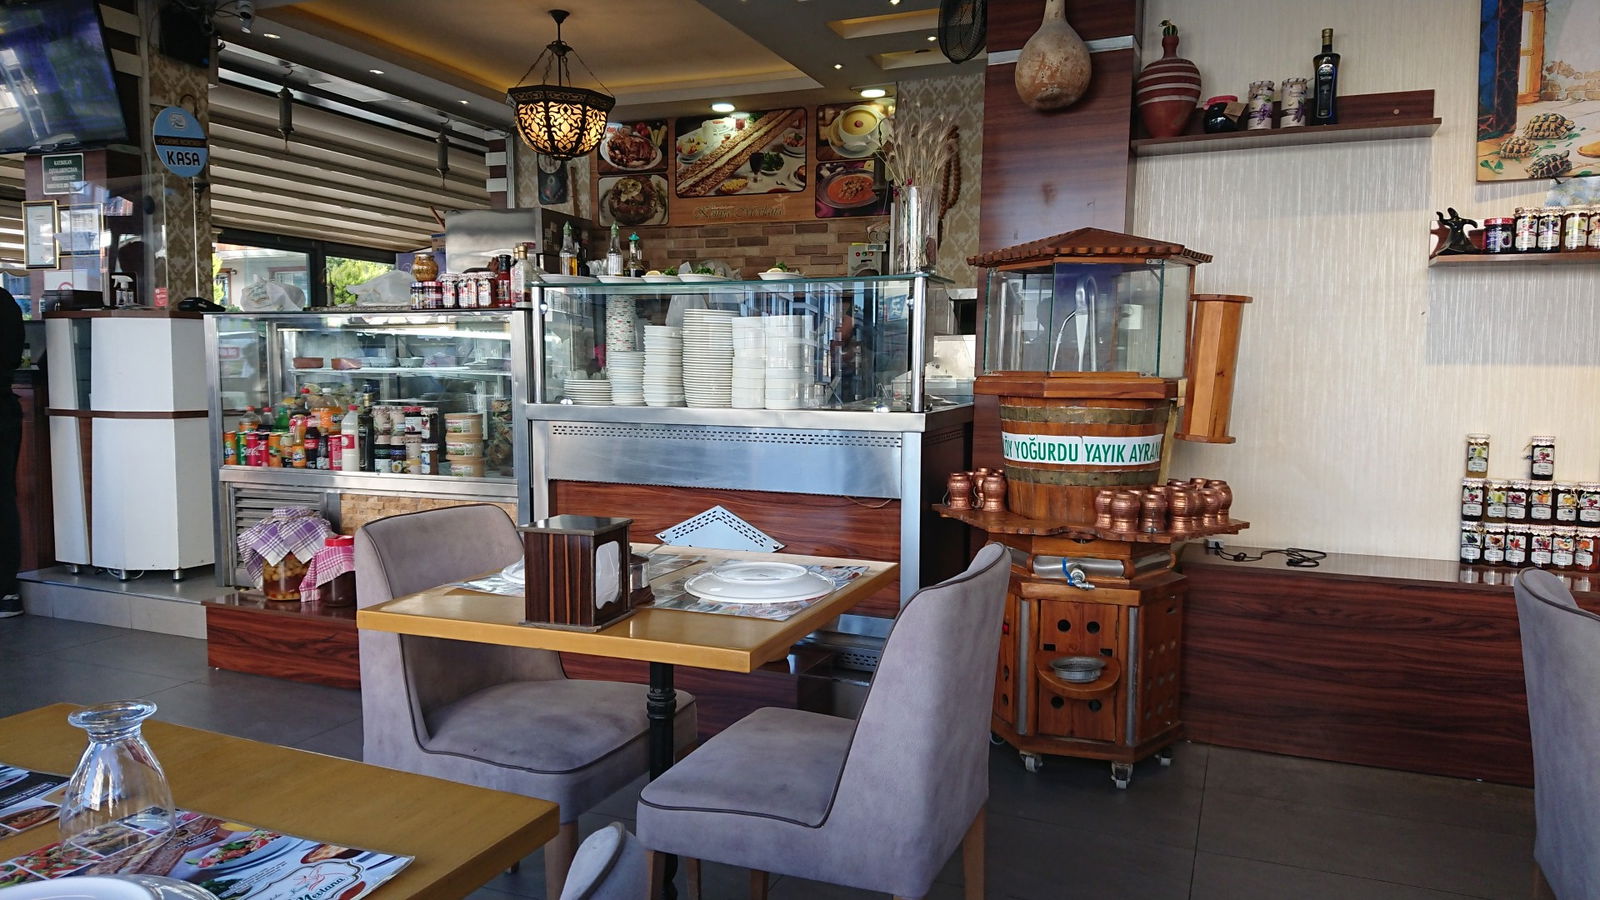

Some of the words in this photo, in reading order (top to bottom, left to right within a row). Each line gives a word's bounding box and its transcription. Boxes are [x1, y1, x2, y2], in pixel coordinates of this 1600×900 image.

[166, 150, 201, 166] KASA
[1014, 436, 1078, 462] YOĞURDU
[1084, 443, 1126, 463] YAYIK
